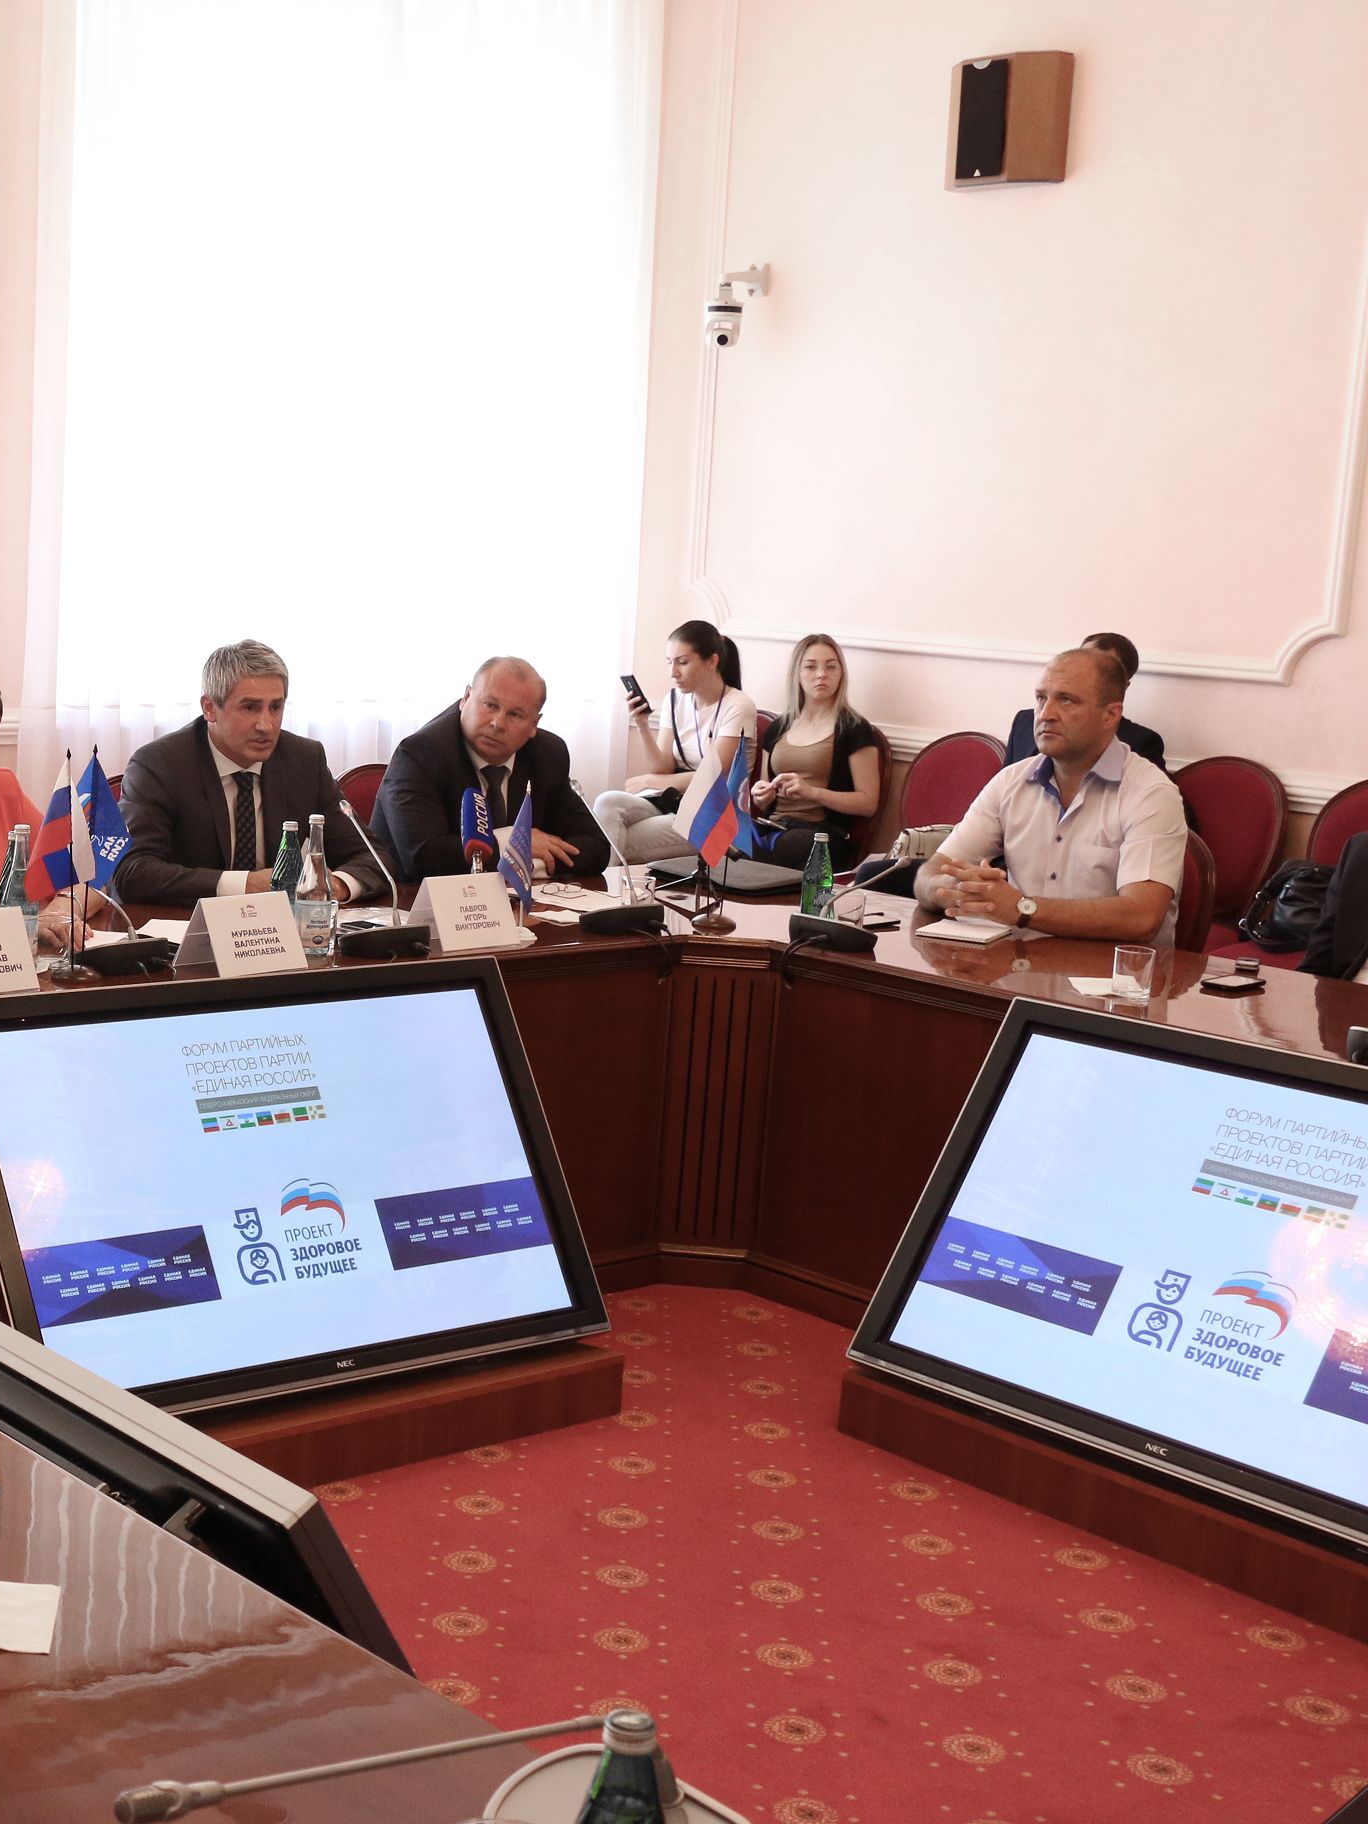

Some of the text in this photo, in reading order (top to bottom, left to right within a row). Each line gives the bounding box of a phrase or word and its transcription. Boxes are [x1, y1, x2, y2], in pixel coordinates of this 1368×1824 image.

[473, 792, 489, 836] РОССИЯ
[455, 920, 500, 931] ВИКТОРОВИЧ
[464, 914, 487, 922] ИГОРЬ
[231, 926, 278, 938] МУРАВЬЕВА
[234, 937, 280, 948] ВАЛЕНТИНА
[234, 946, 286, 958] НИКОЛАЕВНА
[182, 1033, 306, 1056] ФОРУМ ПАРТИЙНЫХ
[186, 1052, 312, 1076] ПРОЕКТОВ ПАРТИИ
[192, 1068, 316, 1095] «ЕДИНАЯ РОССИЯ»
[1216, 1124, 1303, 1154] ПРОЕКТОВ
[1226, 1108, 1368, 1150] ФОРУМ ПАРТИЙНЫ
[1210, 1142, 1282, 1170] «ЕДИНАЯ
[1285, 1159, 1366, 1188] РОССИЯ»
[284, 1223, 333, 1242] ПРОЕКТ
[290, 1238, 362, 1261] ЗДОРОВОЕ
[294, 1258, 358, 1279] БУДУЩЕЕ
[1200, 1309, 1264, 1338] ПРОЕКТ
[1192, 1328, 1285, 1366] ЗДОРОВОЕ
[336, 1359, 356, 1368] NEC
[1184, 1346, 1264, 1381] БУДУЩЕЕ
[1144, 1442, 1168, 1456] NEC
